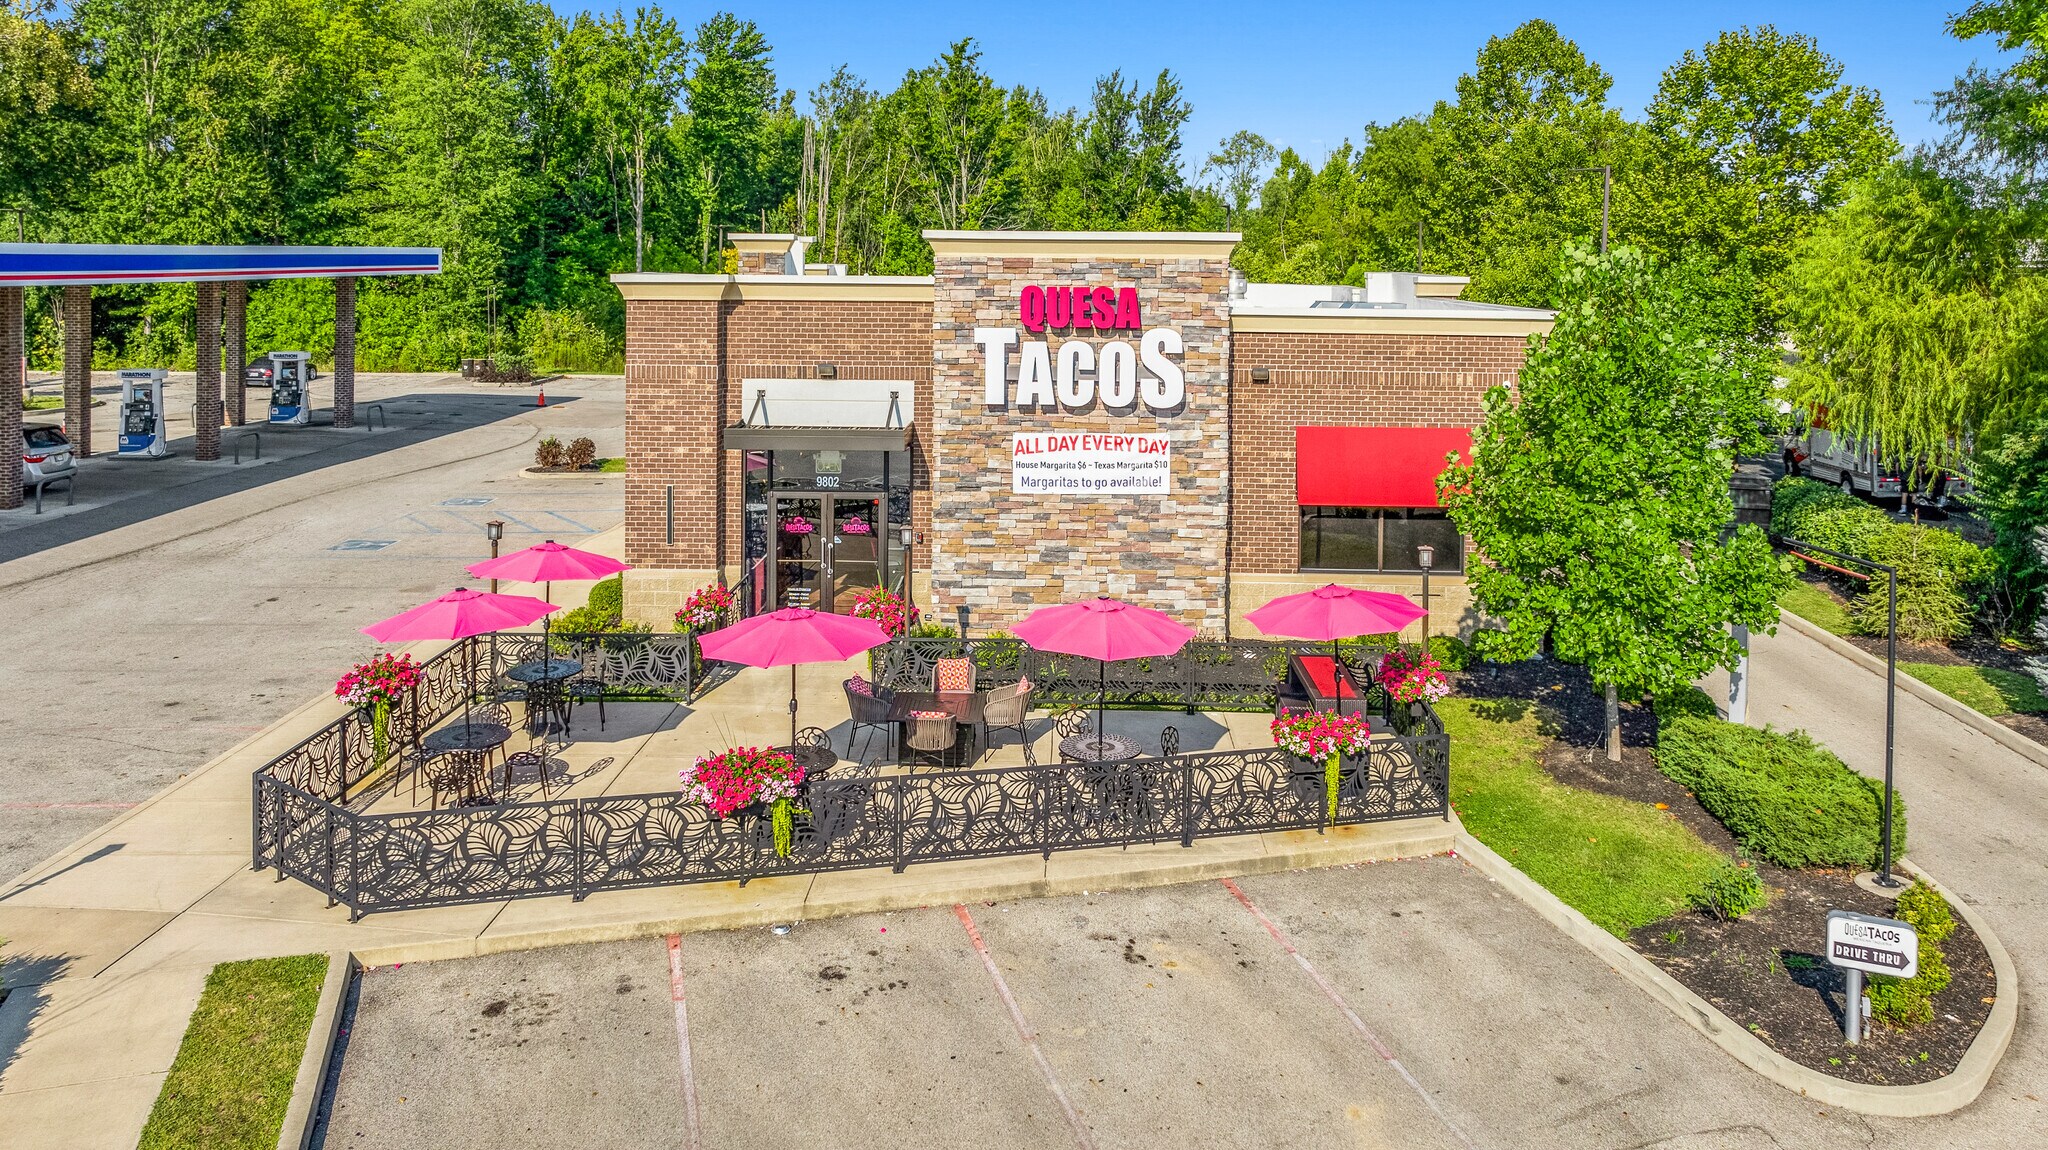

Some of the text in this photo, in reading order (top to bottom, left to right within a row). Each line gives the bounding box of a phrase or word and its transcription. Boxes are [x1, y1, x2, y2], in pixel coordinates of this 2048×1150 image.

[1020, 285, 1141, 332] QUESA
[974, 327, 1184, 409] TACOS
[1014, 434, 1169, 456] ALL DAY EVERY DAY
[1015, 461, 1039, 469] House
[1040, 461, 1076, 471] Margarita
[1077, 460, 1087, 470] $6
[1094, 461, 1115, 469] Texas
[1116, 461, 1153, 471] Margarita
[1154, 460, 1168, 469] $10
[816, 476, 840, 488] 9802
[1021, 476, 1162, 490] Margaritas to go available!
[1835, 944, 1900, 966] DRIVE THRU
